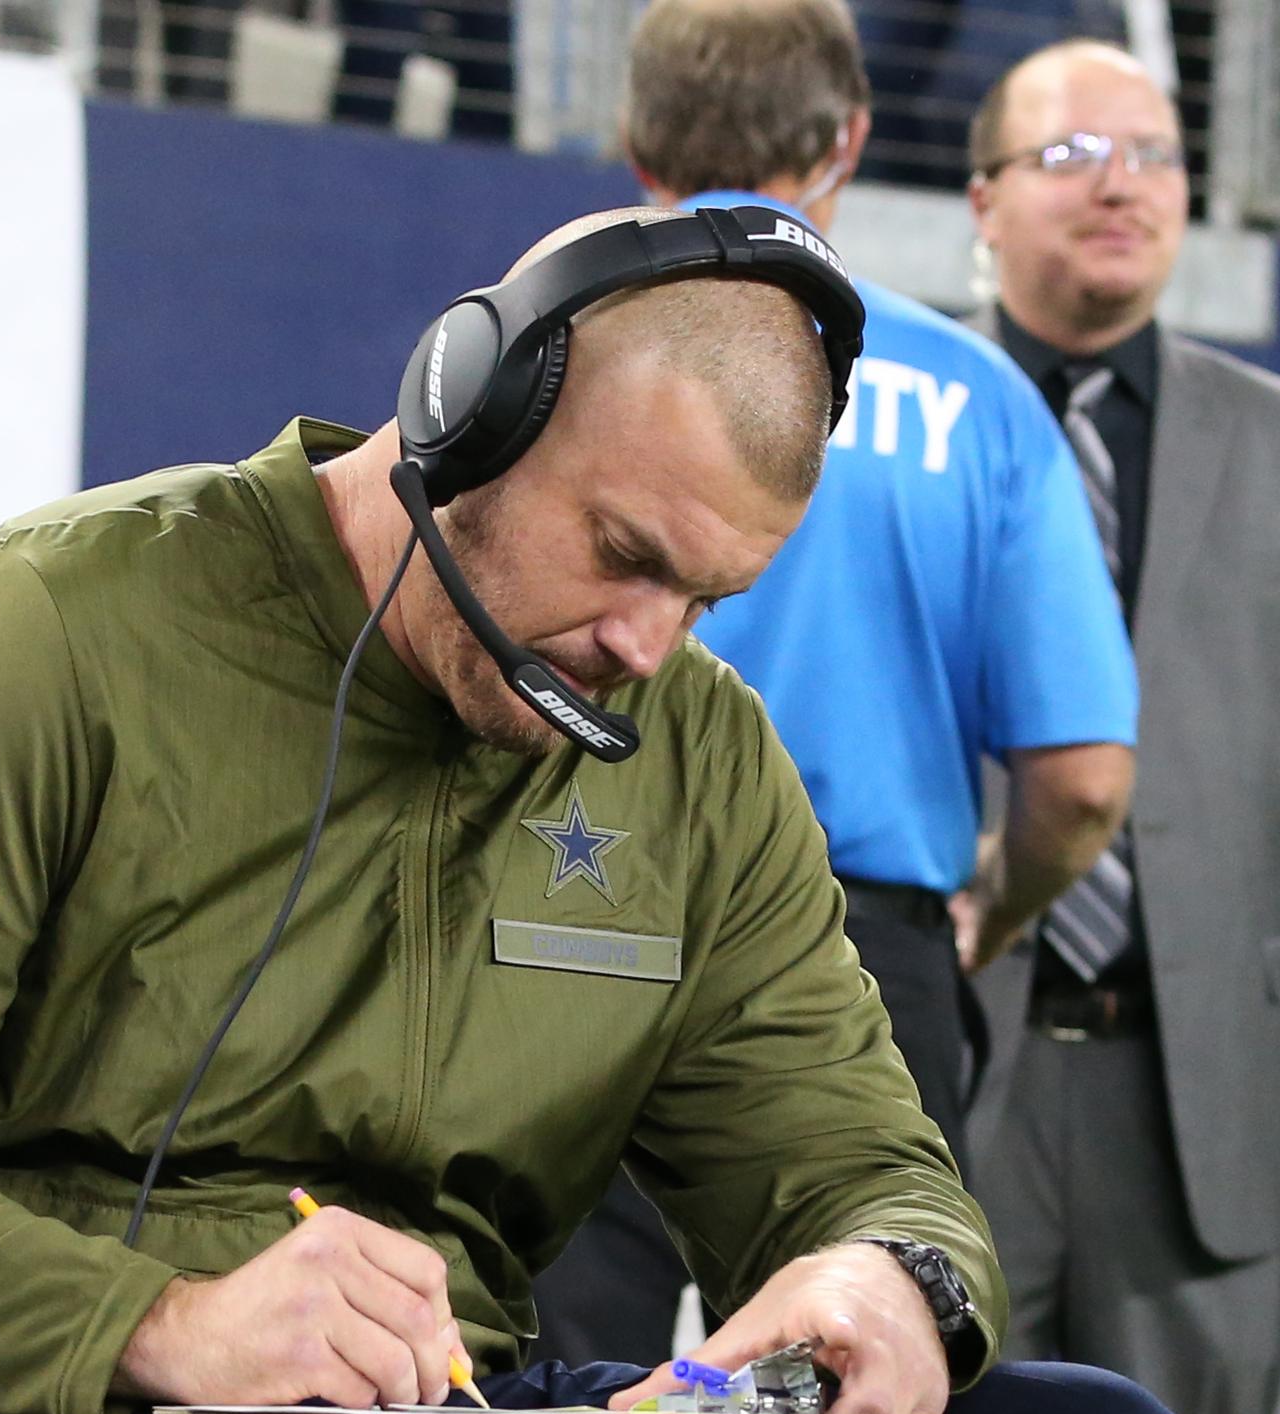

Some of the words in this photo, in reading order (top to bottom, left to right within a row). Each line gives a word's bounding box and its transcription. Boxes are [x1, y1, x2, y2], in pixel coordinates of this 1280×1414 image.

[746, 217, 850, 281] BOS
[428, 312, 448, 433] BOSE
[830, 355, 971, 474] ITY
[517, 678, 627, 749] BOSE
